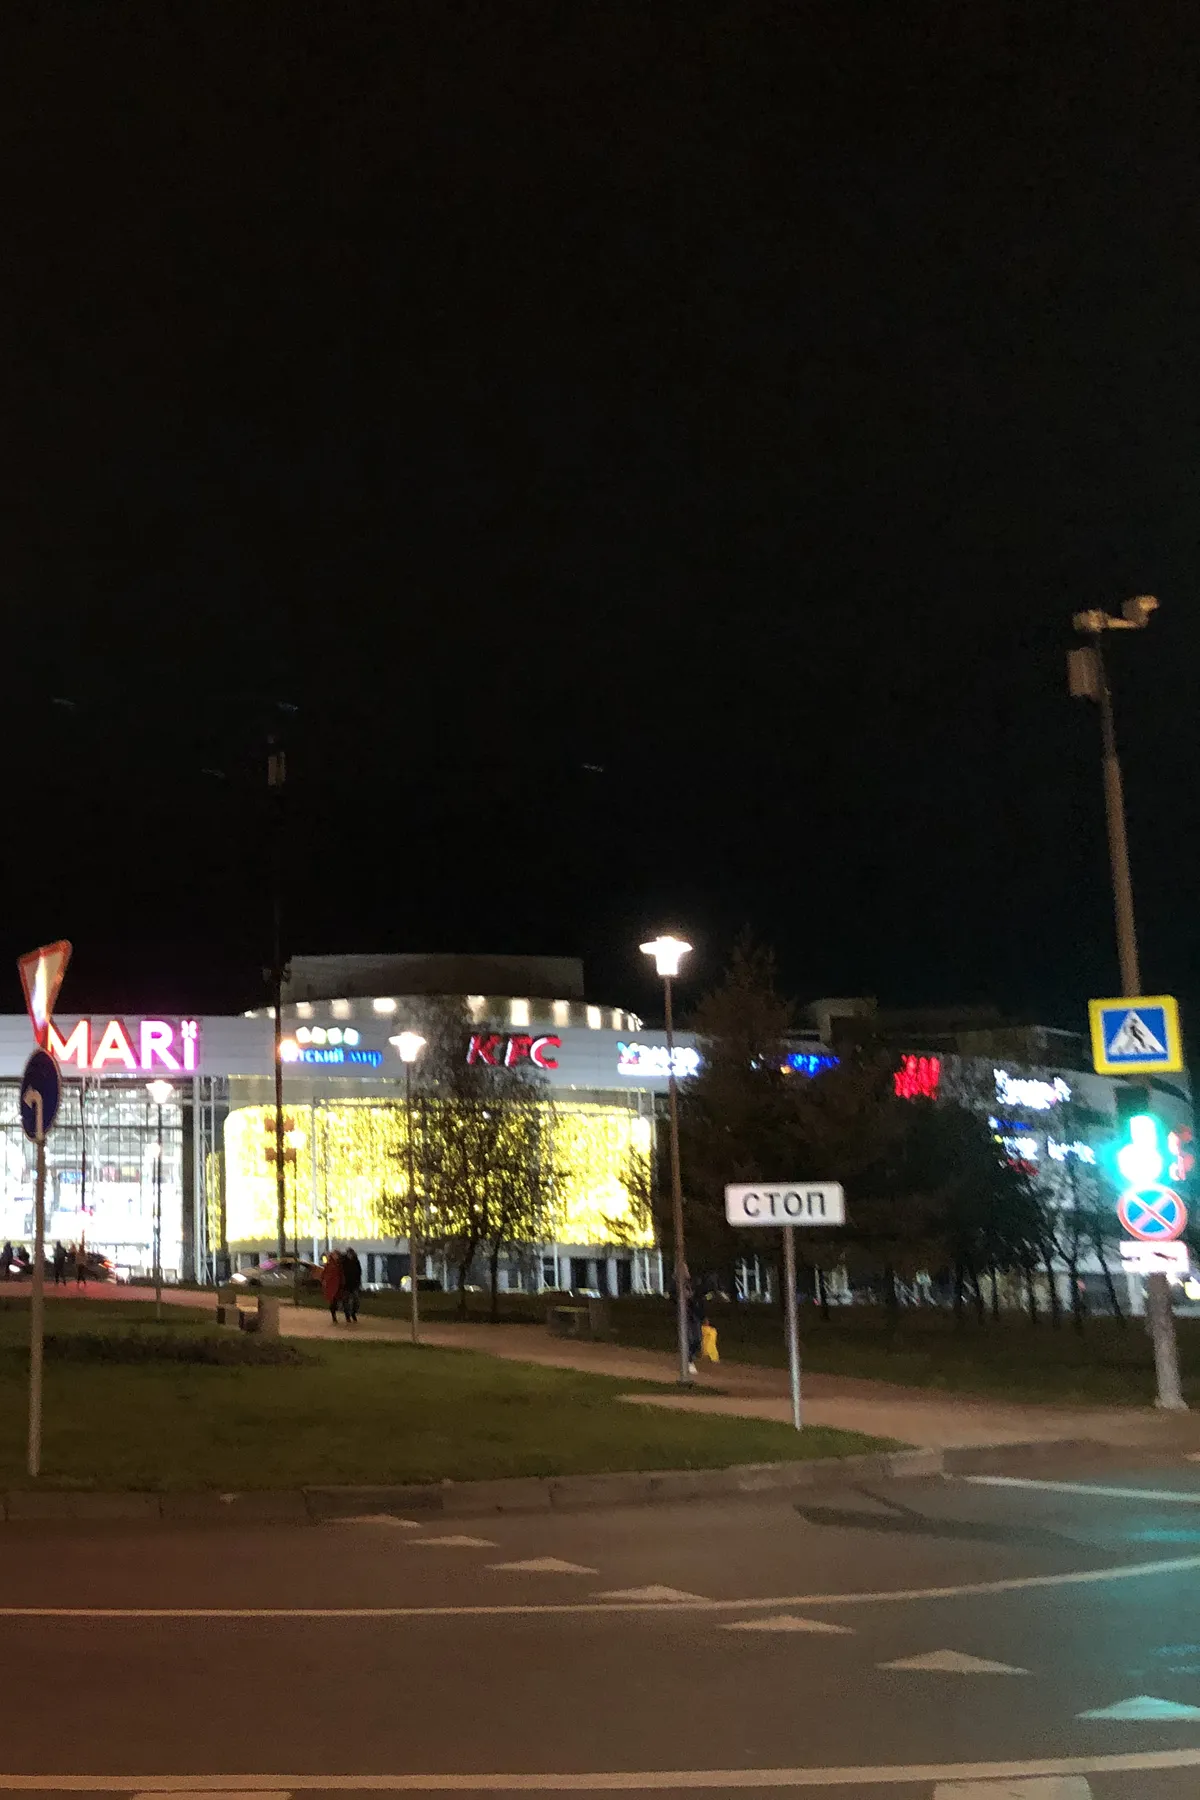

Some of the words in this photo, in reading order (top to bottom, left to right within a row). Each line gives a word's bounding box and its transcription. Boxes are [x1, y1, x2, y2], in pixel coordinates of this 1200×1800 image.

[282, 1047, 345, 1063] тский
[466, 1034, 563, 1070] KFC
[742, 1190, 826, 1217] СТОП
